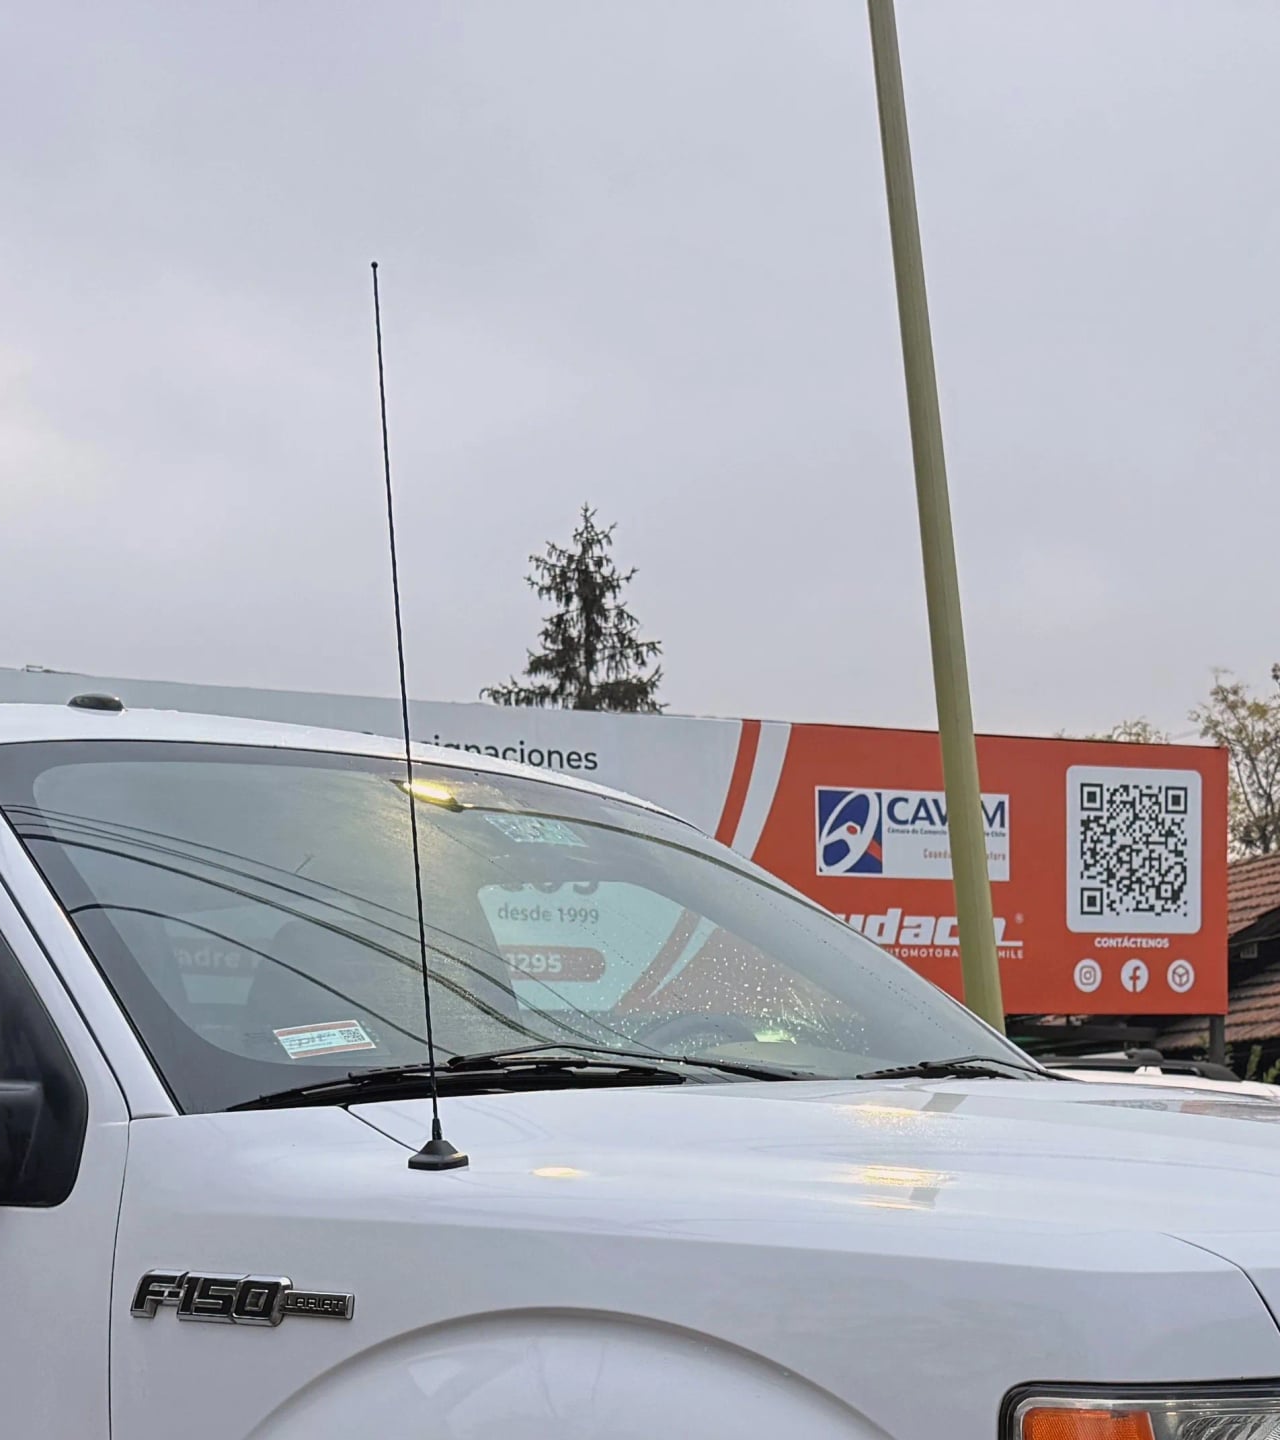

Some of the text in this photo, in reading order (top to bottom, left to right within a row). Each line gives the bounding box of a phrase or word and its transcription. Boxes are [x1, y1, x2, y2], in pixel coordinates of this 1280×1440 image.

[887, 797, 1006, 829] CAVM
[498, 901, 600, 924] desde 1999
[1094, 935, 1170, 949] CONTÁCTENOS
[998, 949, 1024, 960] HILE
